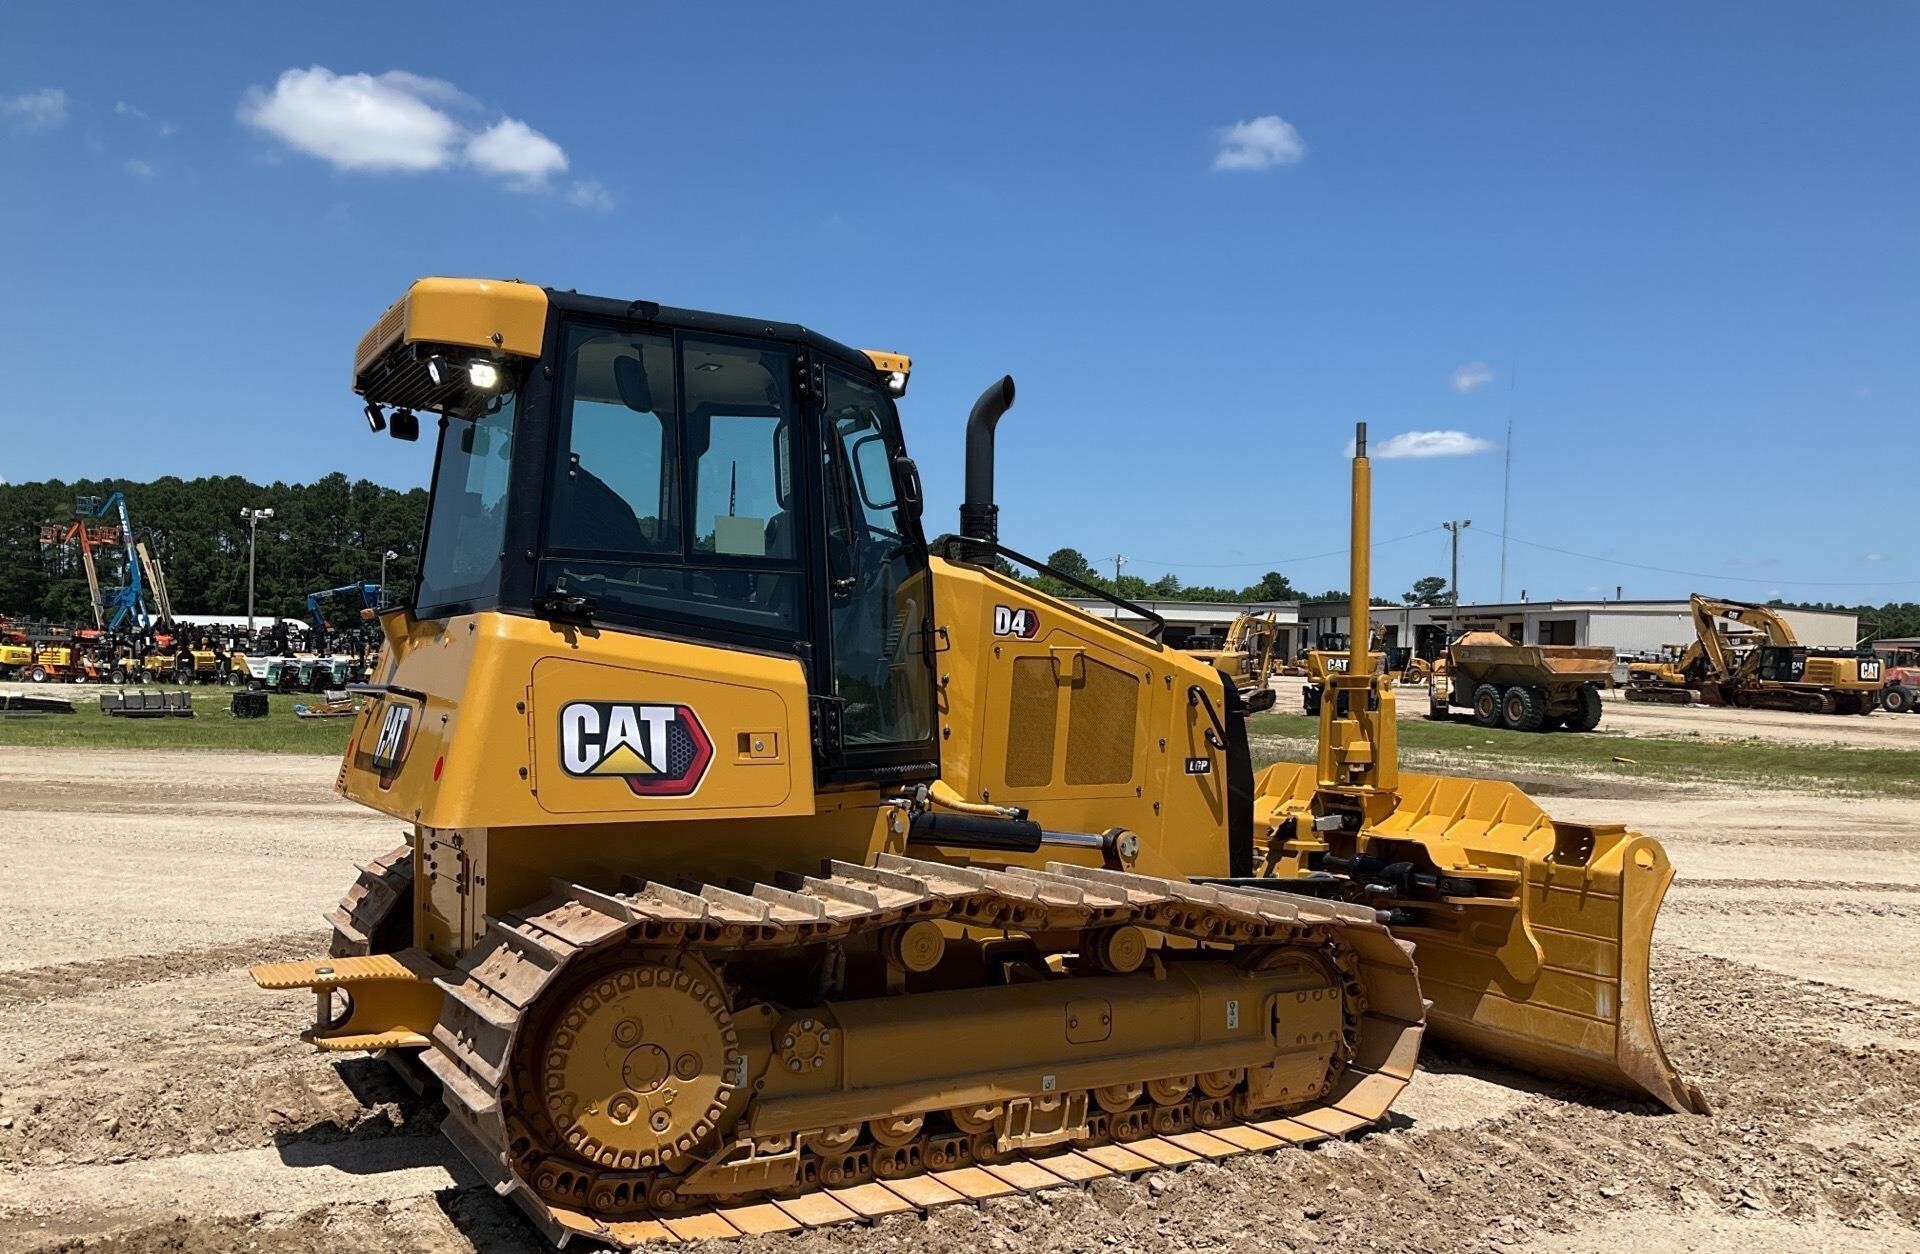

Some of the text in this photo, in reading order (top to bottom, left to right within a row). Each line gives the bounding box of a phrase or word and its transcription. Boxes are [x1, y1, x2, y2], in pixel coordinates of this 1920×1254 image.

[995, 606, 1026, 637] D4
[1327, 658, 1349, 672] CAT
[1792, 662, 1803, 671] CAT
[1861, 662, 1879, 679] CAT
[373, 705, 411, 768] CAT
[562, 703, 675, 774] CAT
[1189, 760, 1208, 771] LGP
